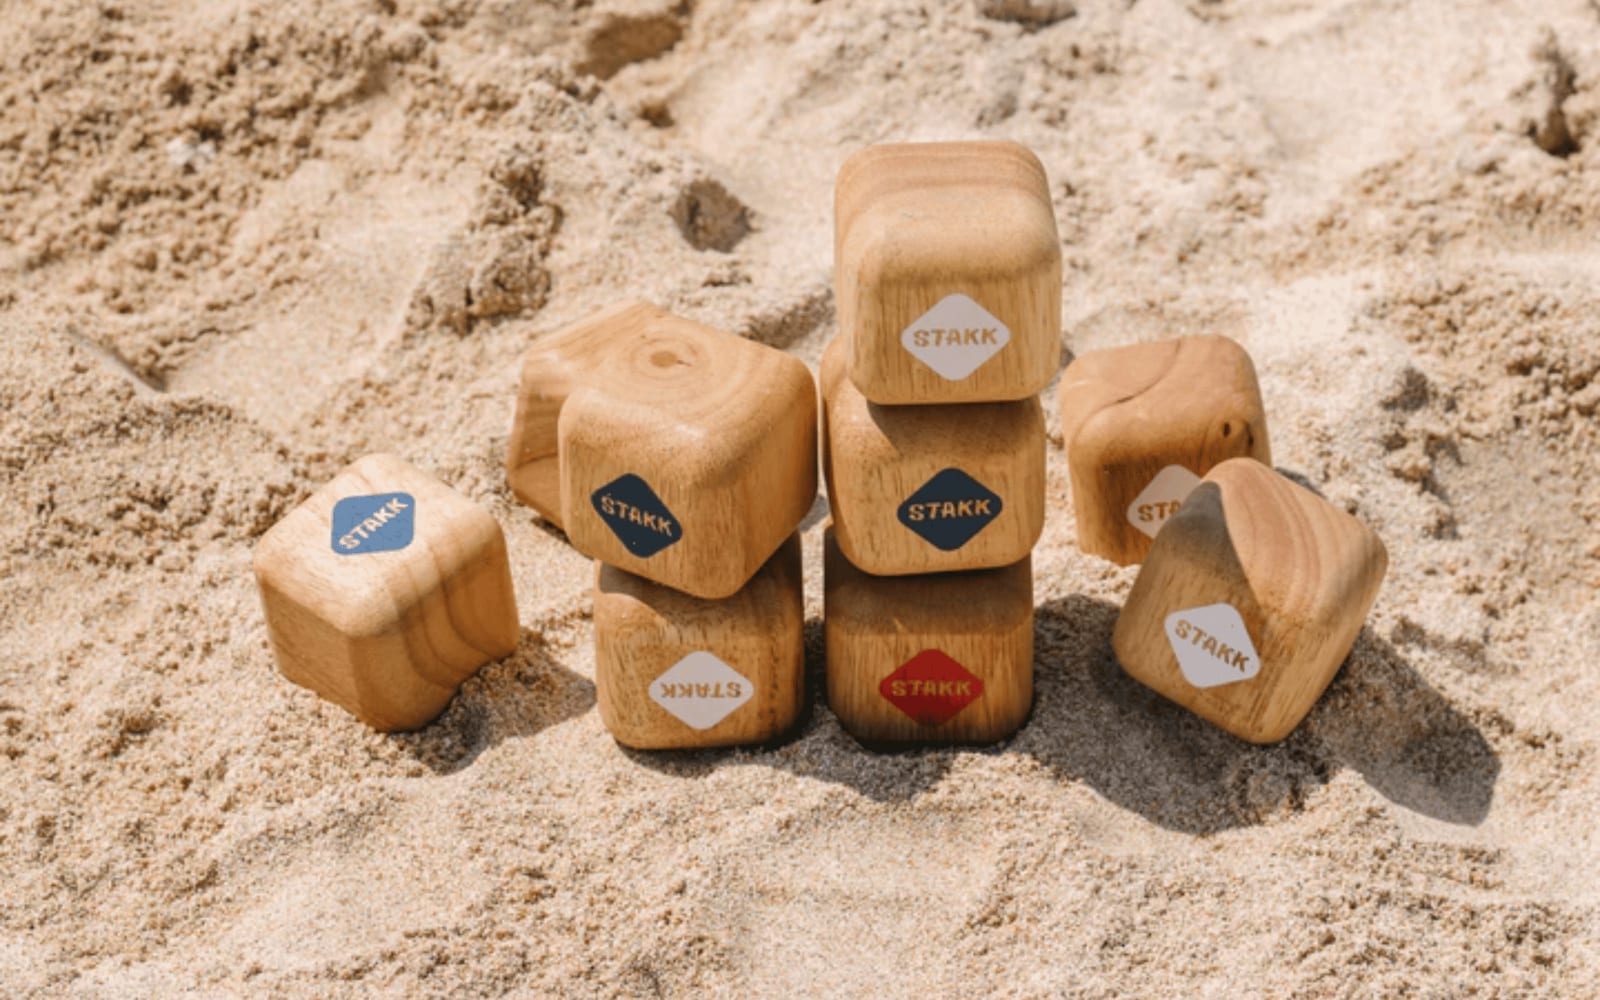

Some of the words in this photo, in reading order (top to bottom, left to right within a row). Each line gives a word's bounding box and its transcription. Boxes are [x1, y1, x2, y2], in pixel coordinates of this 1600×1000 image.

[912, 328, 997, 347] STAKK
[600, 494, 673, 537] STAKK
[906, 499, 990, 521] STAKK
[1137, 499, 1181, 522] STA
[338, 497, 409, 550] STAKK
[1174, 619, 1250, 673] STAKK
[660, 682, 742, 699] STAKK
[891, 679, 971, 697] STAKK
